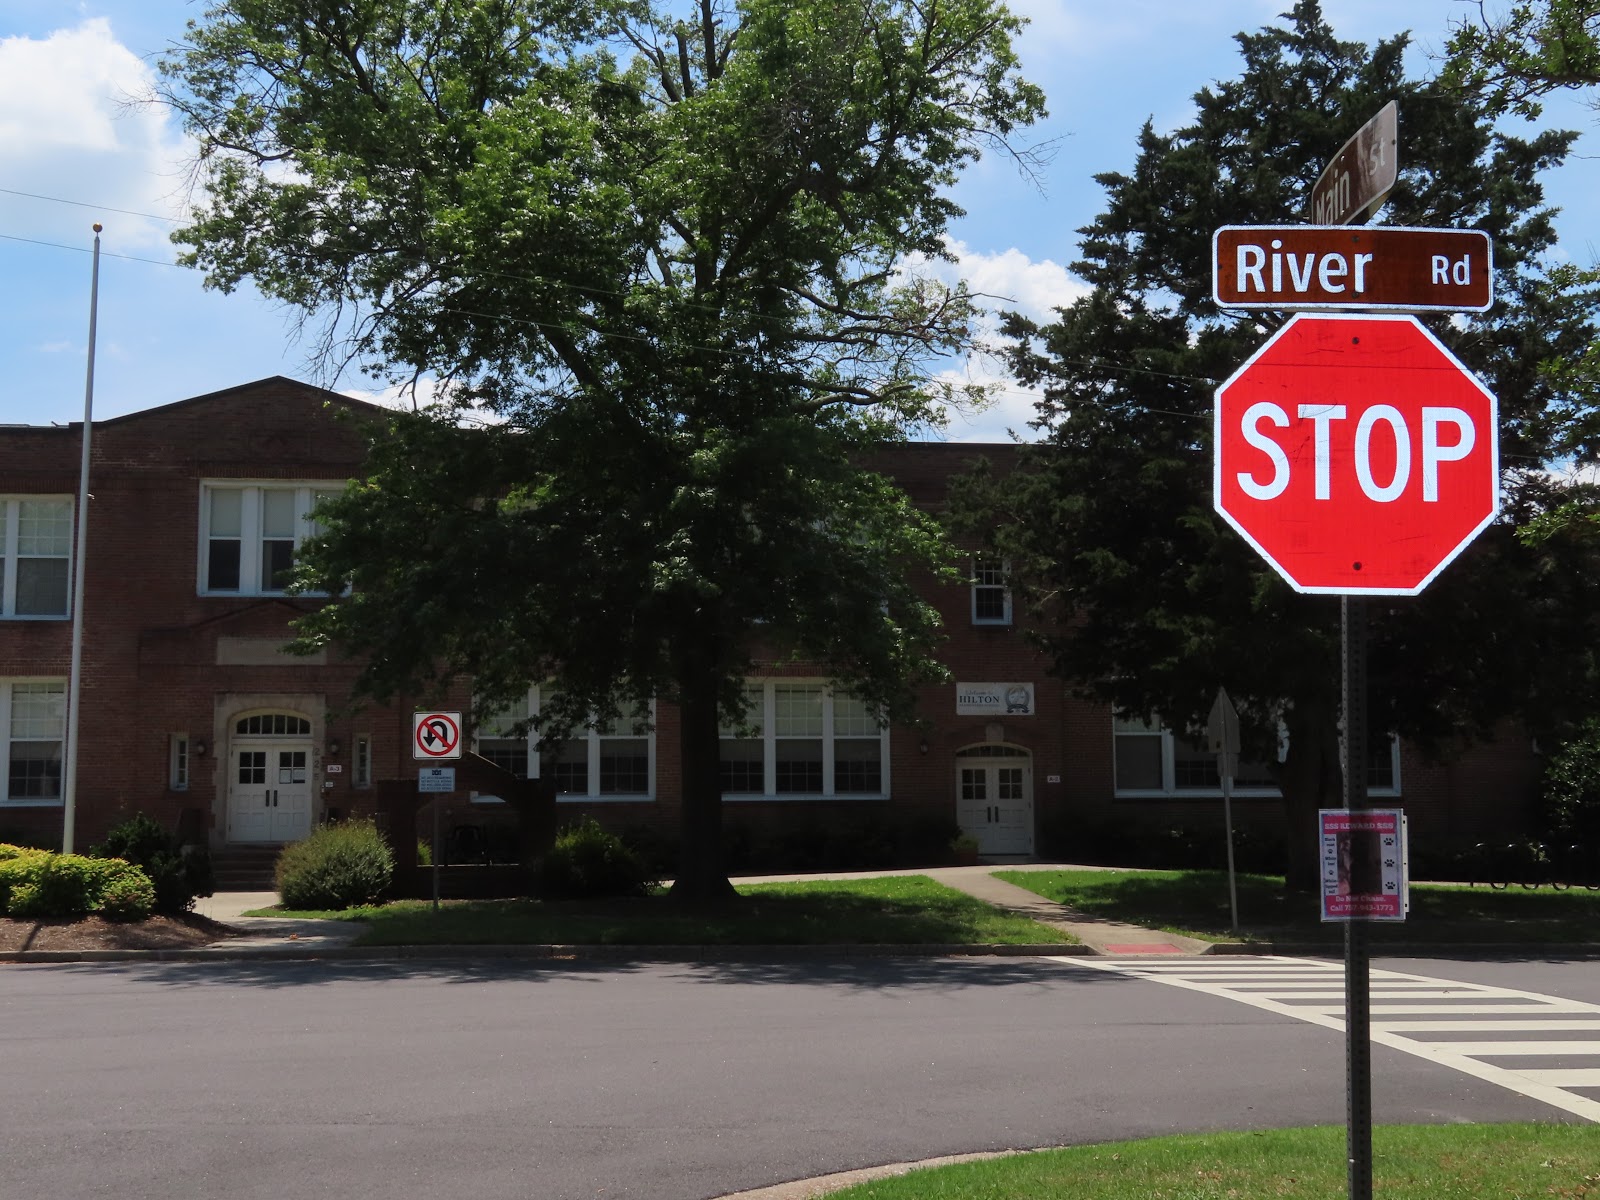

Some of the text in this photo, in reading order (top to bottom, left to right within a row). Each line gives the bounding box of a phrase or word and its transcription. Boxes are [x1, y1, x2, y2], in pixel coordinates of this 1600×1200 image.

[1316, 136, 1386, 225] Main St
[1236, 239, 1470, 293] River Rd
[1236, 401, 1476, 503] STOP
[959, 695, 1000, 703] HILTON
